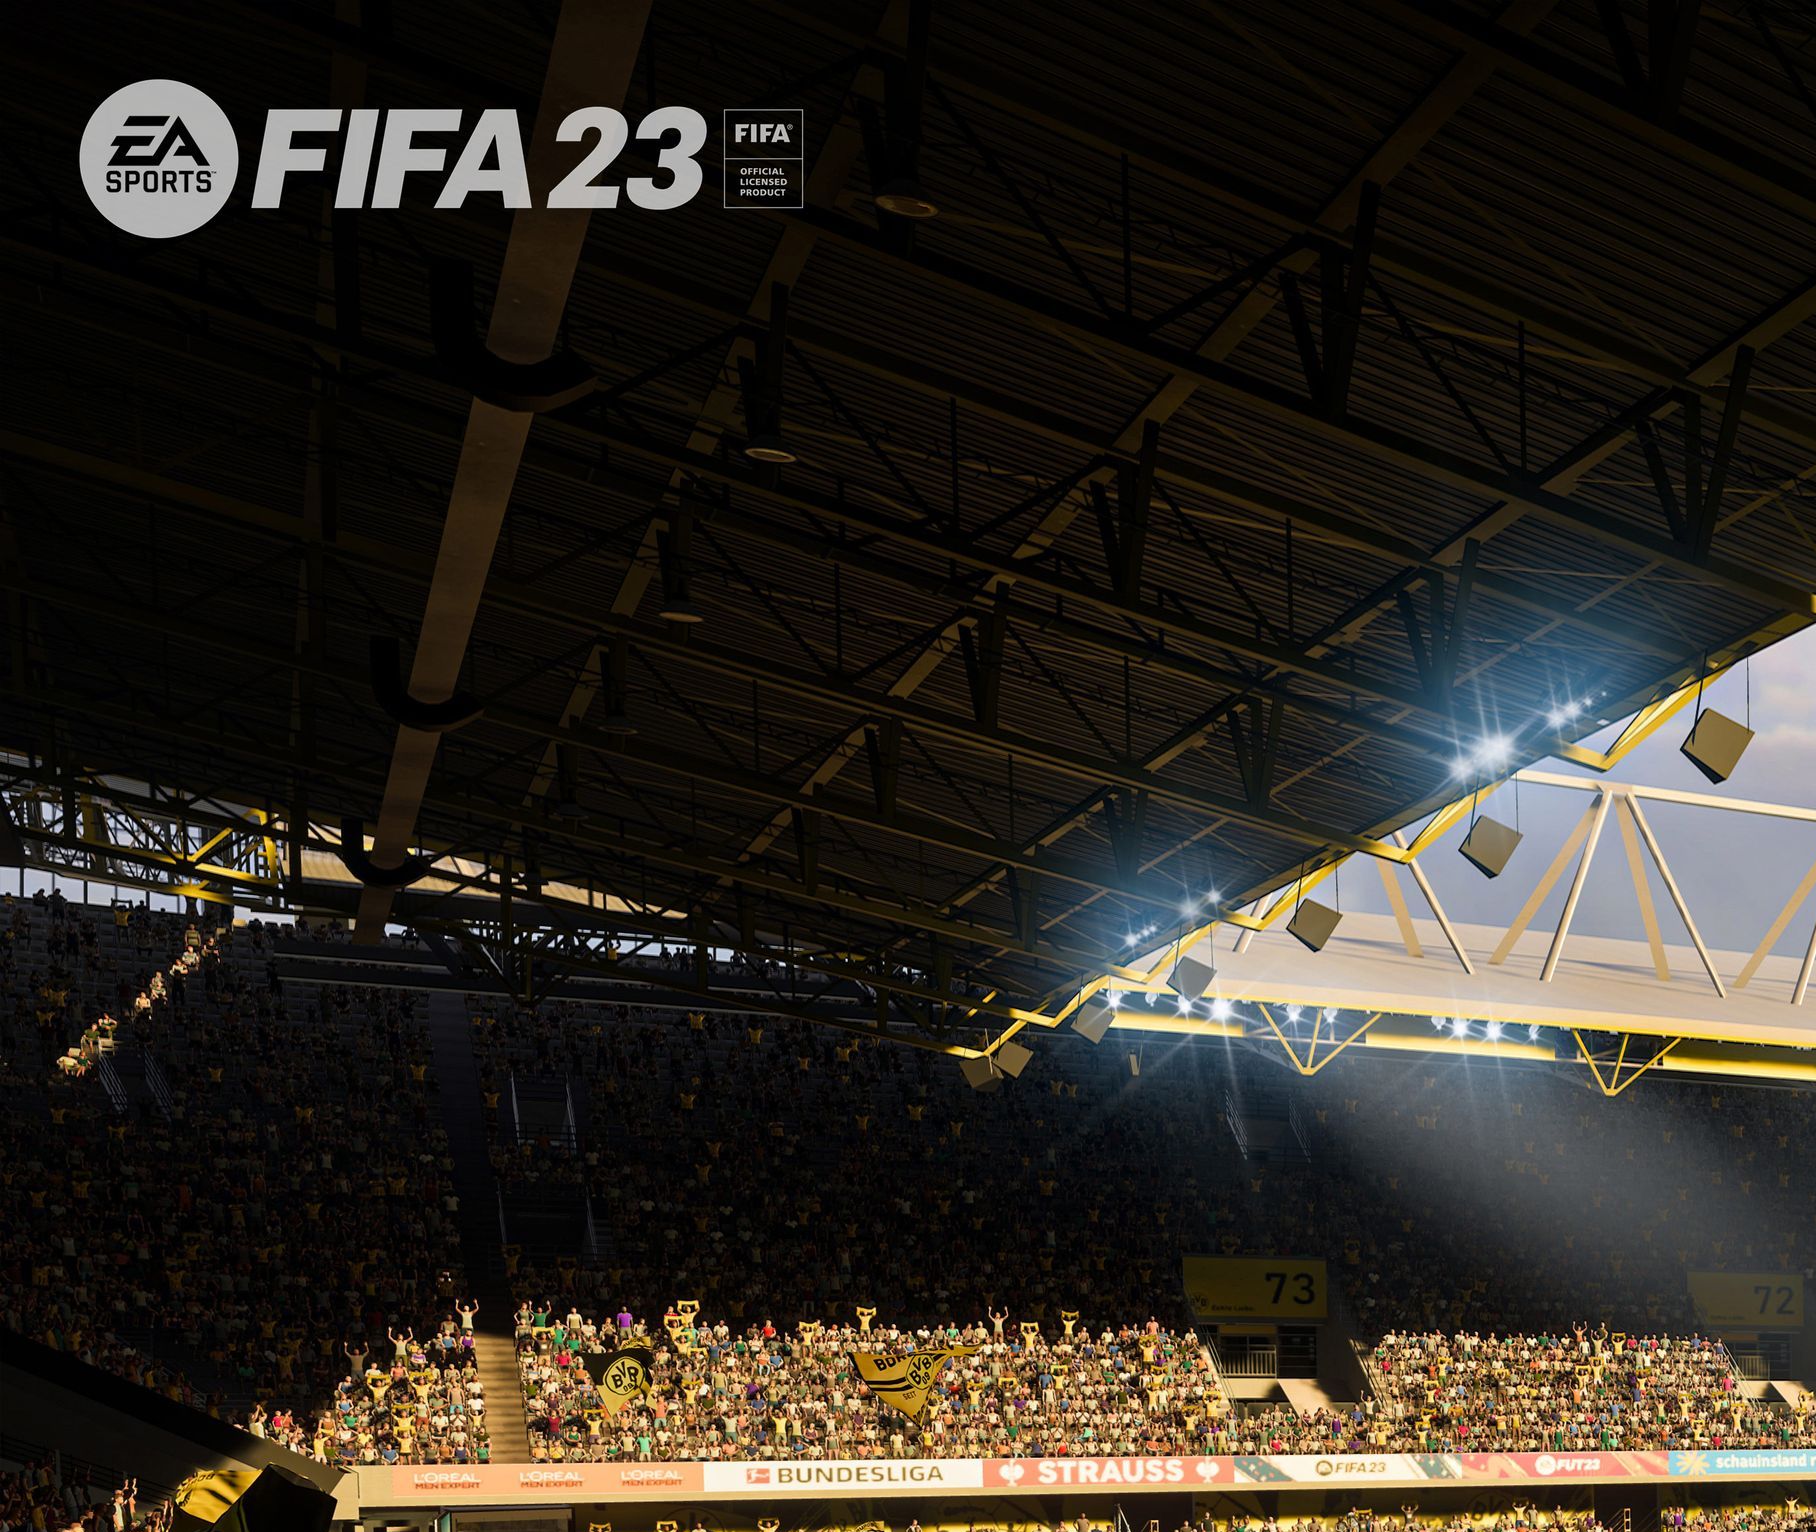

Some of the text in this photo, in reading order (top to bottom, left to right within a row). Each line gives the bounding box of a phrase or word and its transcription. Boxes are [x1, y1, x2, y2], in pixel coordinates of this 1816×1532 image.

[1265, 1273, 1315, 1305] 73
[1754, 1286, 1796, 1316] 72
[1038, 1459, 1185, 1484] STRAUSS
[1335, 1462, 1387, 1473] FIFA 23
[1716, 1453, 1807, 1469] schauinsland
[778, 1466, 943, 1484] BUNDESLIGA
